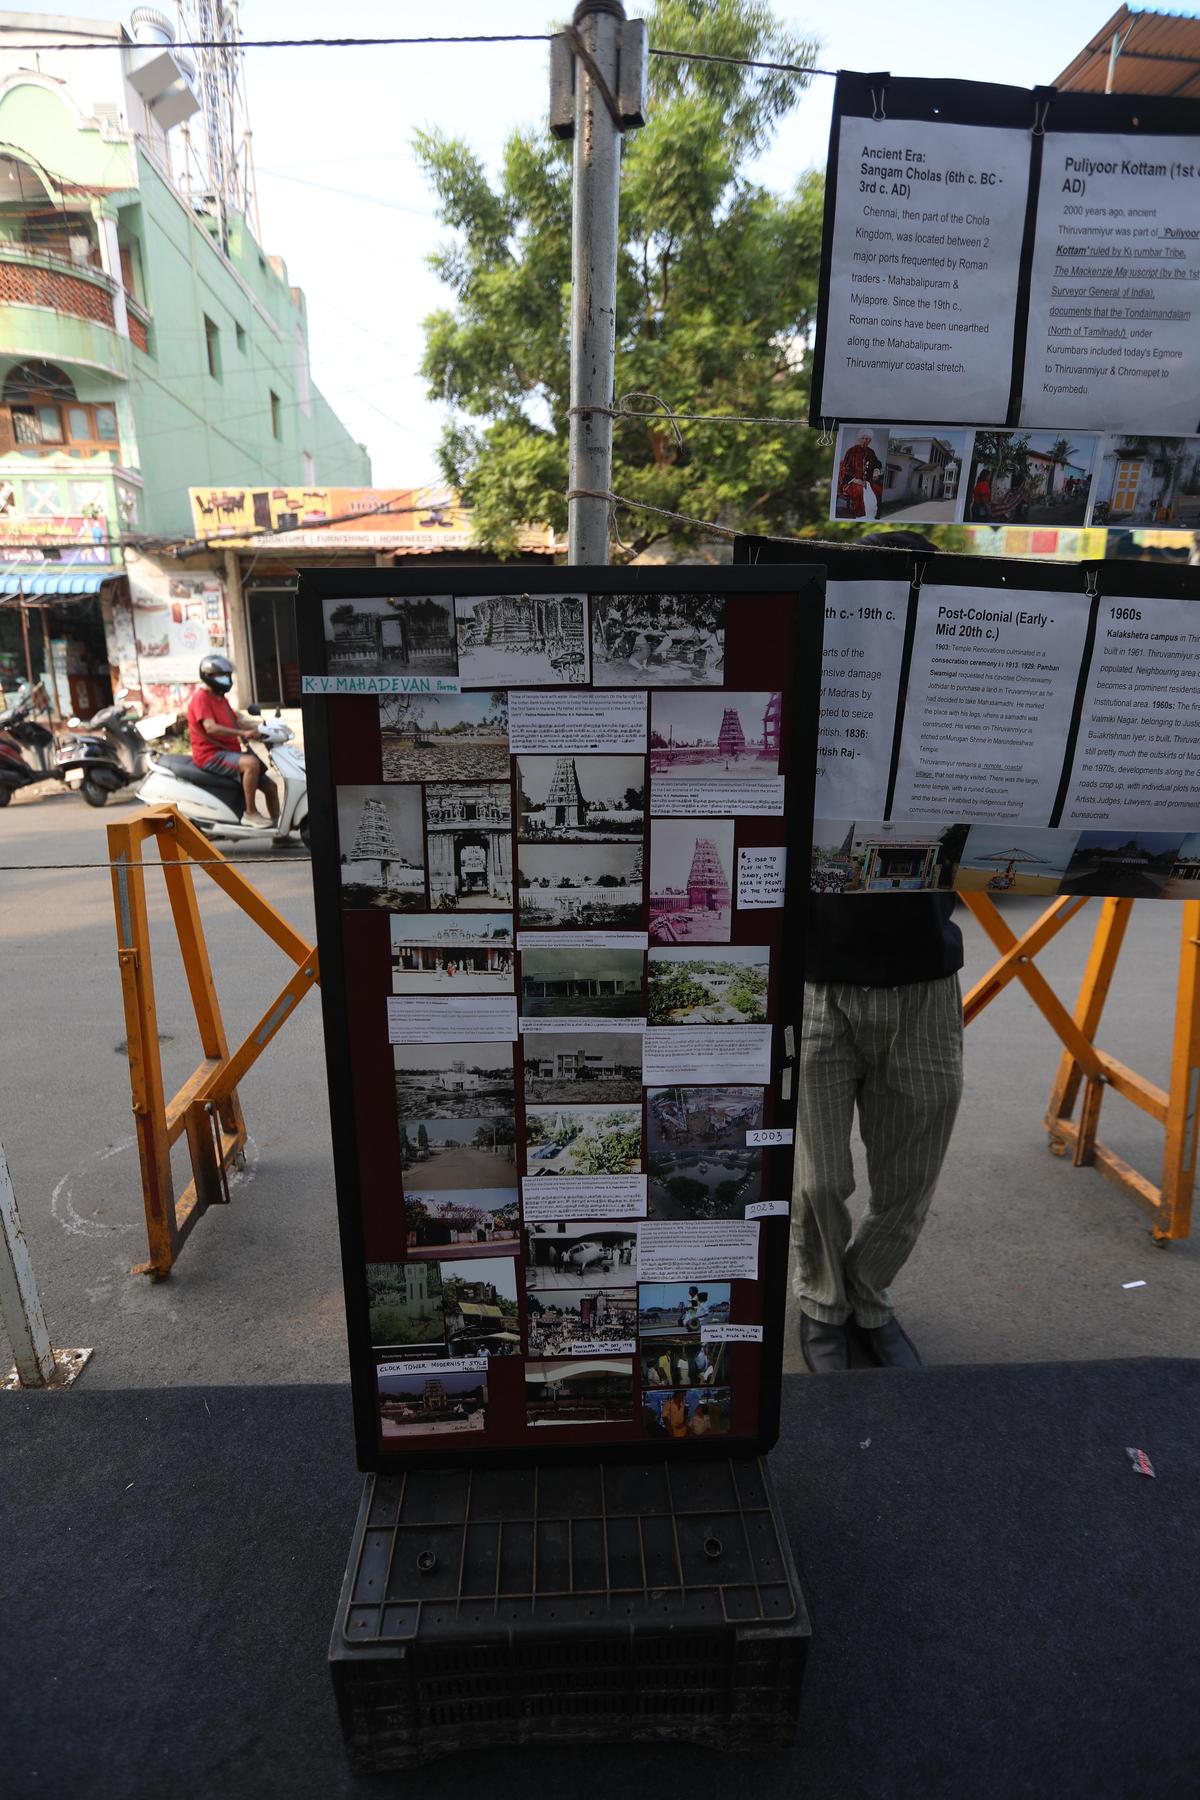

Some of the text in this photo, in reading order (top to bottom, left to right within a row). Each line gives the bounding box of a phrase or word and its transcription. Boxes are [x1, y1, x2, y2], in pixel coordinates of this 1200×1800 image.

[861, 146, 925, 162] Ancient Era:
[860, 162, 995, 185] Sangam Cholas (6th c. BC
[1065, 157, 1117, 175] Puliyoor
[1121, 160, 1166, 175] Kottam
[1170, 162, 1194, 179] (1st
[859, 180, 910, 198] 3rd c. AD)
[1061, 178, 1085, 196] AD)
[902, 209, 920, 220] then
[922, 212, 938, 222] part
[940, 212, 949, 222] of
[950, 213, 963, 223] the
[965, 214, 989, 225] Chola
[1063, 204, 1083, 215] 2000
[1084, 207, 1106, 217] years
[1127, 208, 1156, 216] ancient
[1058, 224, 1112, 236] Thiruvanmiyur
[1132, 228, 1148, 237] part
[1150, 227, 1158, 236] of
[896, 233, 913, 242] was
[914, 232, 944, 244] located
[946, 235, 981, 246] between
[983, 237, 989, 248] 2
[1090, 246, 1110, 257] ruled
[1112, 246, 1122, 258] by
[853, 250, 987, 270] major ports frequented by Roman
[1054, 264, 1069, 277] The
[1072, 266, 1112, 278] Mackenzie
[1174, 268, 1186, 280] the
[851, 272, 958, 289] traders Mahabalipuram &
[1051, 285, 1086, 297] Surveyor
[1088, 286, 1120, 298] General
[892, 296, 915, 307] Since
[917, 298, 930, 308] the
[933, 299, 950, 309] 19th
[1049, 306, 1091, 318] documents
[1094, 306, 1108, 318] that
[1110, 307, 1122, 319] the
[849, 313, 988, 332] Roman coins have been unearthed
[1047, 325, 1152, 339] (North of Tamilnadu) under
[847, 335, 951, 350] along the Mahabalipuram-
[1046, 344, 1087, 354] Kurumbars
[1090, 346, 1122, 356] included
[1152, 348, 1182, 359] Egmore
[846, 356, 903, 370] Thiruvanmiyur
[905, 361, 934, 370] coastal
[1044, 364, 1052, 373] to
[1055, 363, 1107, 376] Thiruvanmiyur
[1109, 365, 1115, 375] &
[1161, 369, 1169, 377] to
[839, 609, 853, 618] c.-
[858, 607, 881, 619] 19th
[885, 610, 895, 620] c.
[938, 606, 1047, 627] Post-Colonial (Early
[1110, 607, 1141, 620] 1960s
[935, 623, 999, 641] Mid 20th c.)
[1106, 629, 1178, 642] Kalakshetra campus
[840, 647, 849, 657] of
[851, 648, 864, 657] the
[847, 668, 881, 680] damage
[828, 687, 859, 697] Madras
[861, 689, 871, 700] by
[841, 708, 849, 717] to
[851, 710, 873, 718] seize
[845, 728, 868, 738] 1836:
[840, 747, 854, 759] Raj
[753, 1132, 782, 1142] 2003
